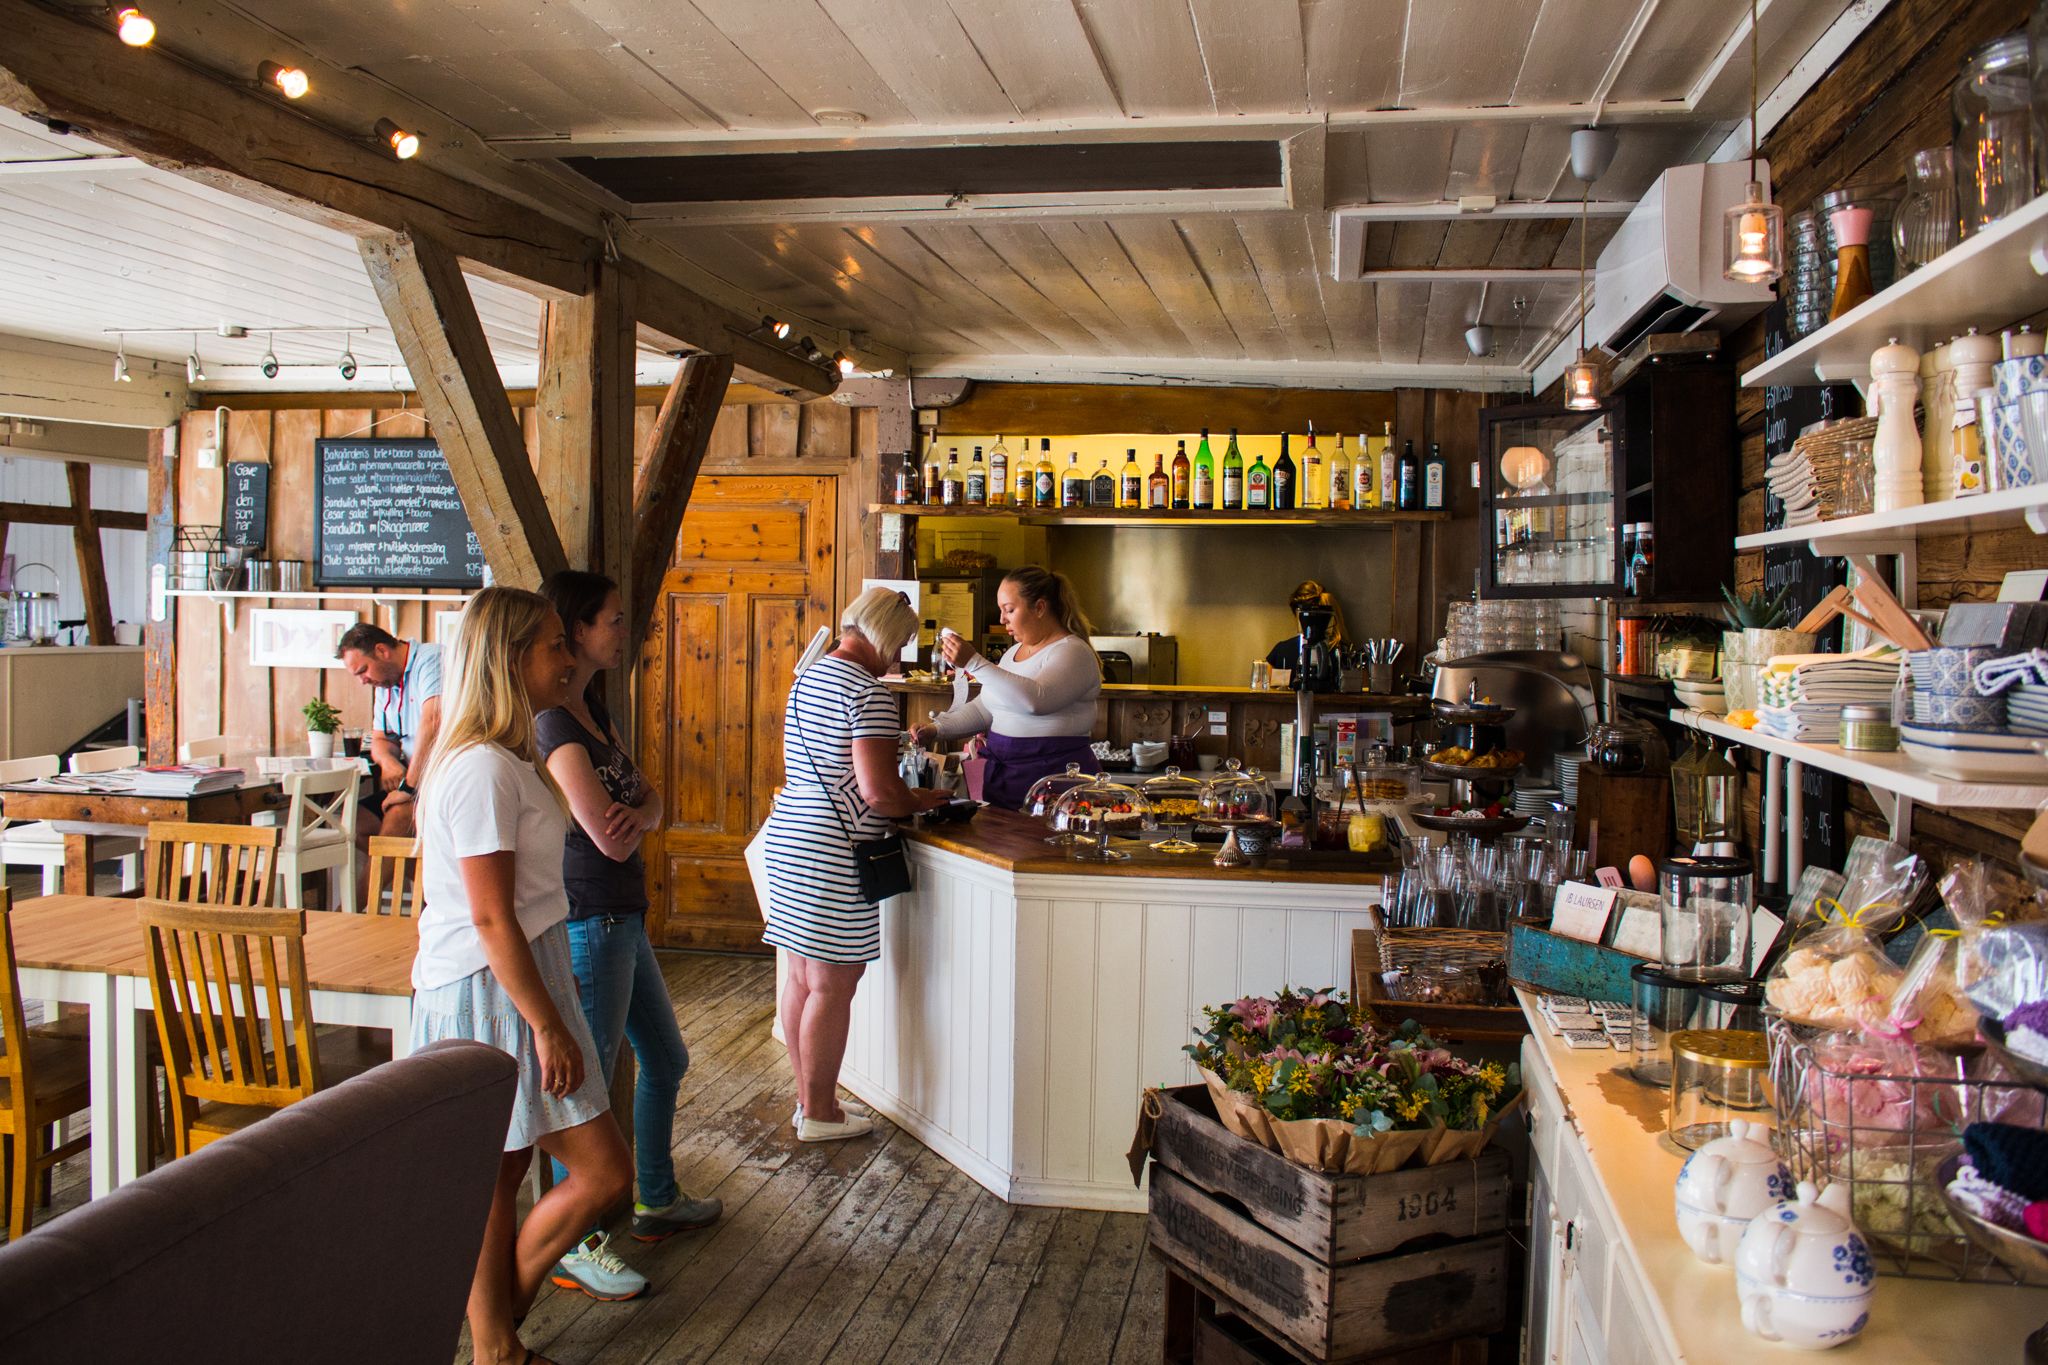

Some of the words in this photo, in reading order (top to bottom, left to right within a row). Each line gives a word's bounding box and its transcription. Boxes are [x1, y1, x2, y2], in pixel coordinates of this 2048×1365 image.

[234, 463, 258, 477] Gave
[324, 461, 357, 473] Sandwich
[235, 493, 254, 507] den
[324, 496, 358, 508] Sandwich
[234, 509, 254, 520] som
[323, 521, 366, 535] Sandwich
[323, 554, 342, 566] Club
[344, 554, 380, 565] sandwich
[1300, 762, 1312, 796] Carlsberg
[1397, 1186, 1457, 1222] 1904
